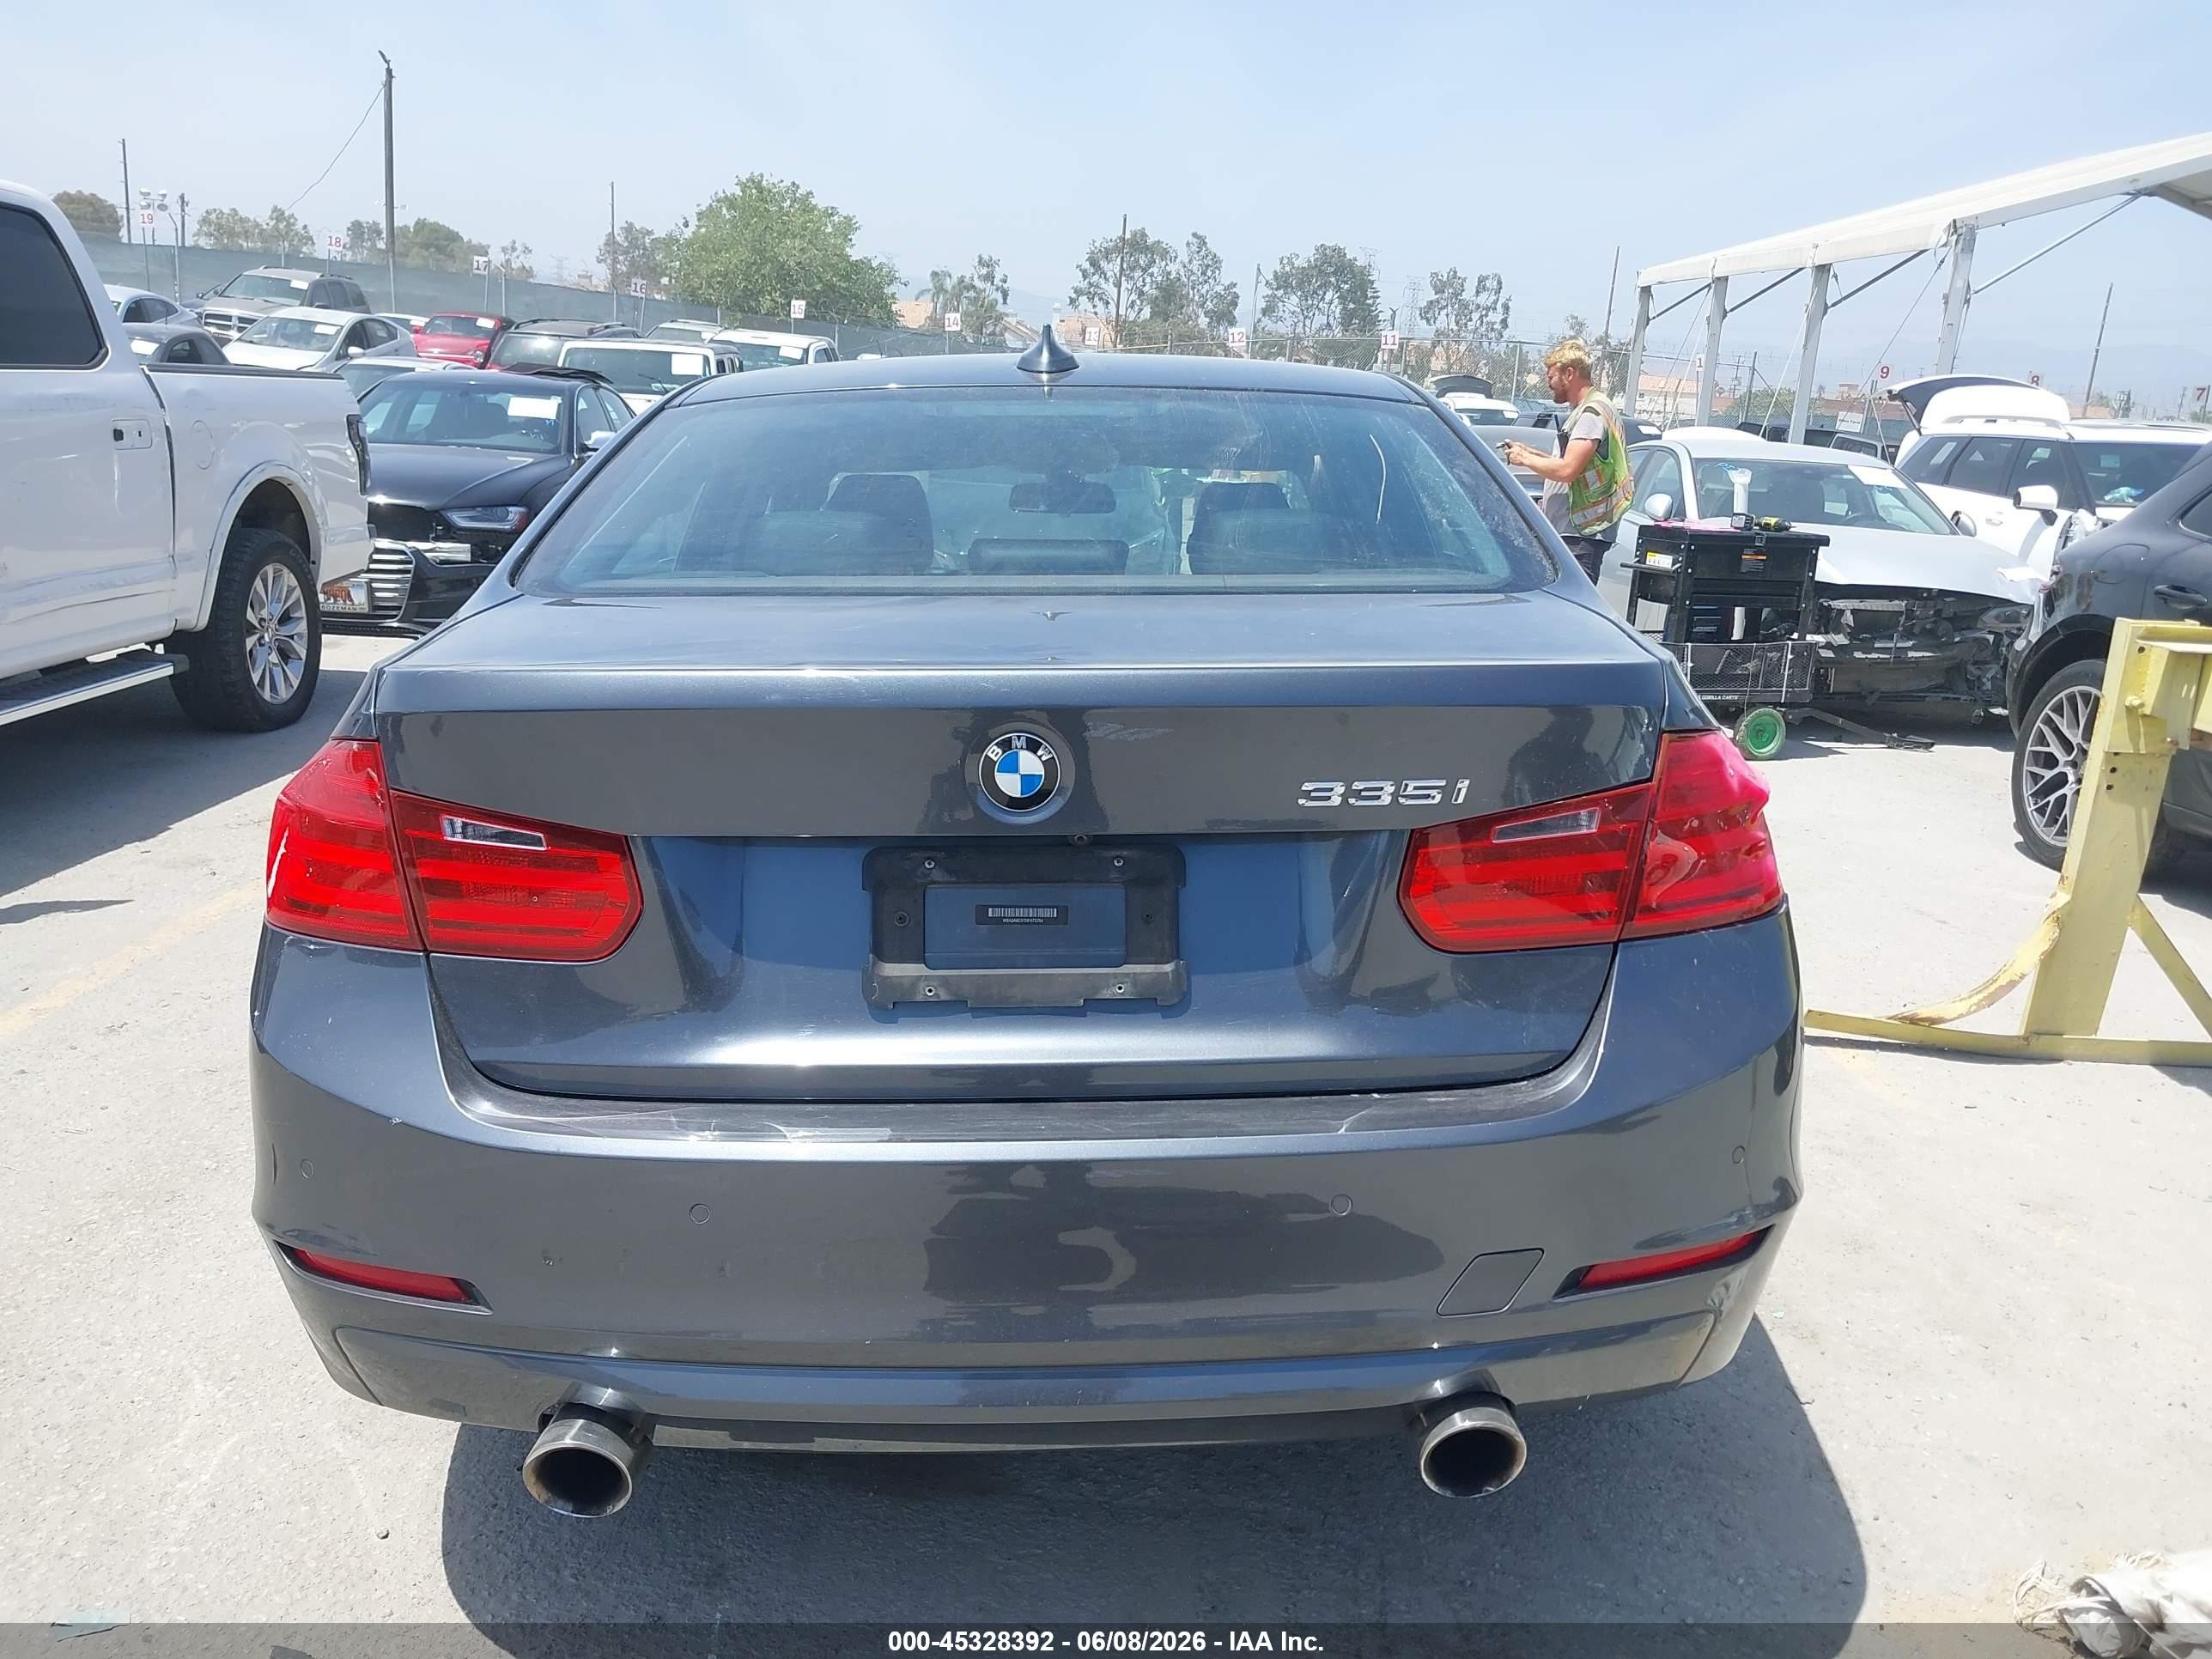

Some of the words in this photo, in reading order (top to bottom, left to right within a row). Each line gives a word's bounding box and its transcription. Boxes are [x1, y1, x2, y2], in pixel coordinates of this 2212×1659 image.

[140, 213, 153, 224] 19
[327, 235, 342, 247] 18
[474, 260, 488, 271] 17
[632, 283, 646, 294] 16
[792, 304, 804, 315] 15
[945, 316, 959, 328] 14
[1230, 331, 1245, 343] 12
[1382, 334, 1398, 345] 11
[1880, 366, 1890, 379] 9
[2030, 375, 2039, 386] 8
[2197, 387, 2206, 401] 7
[987, 736, 1054, 762] BMW
[1297, 779, 1470, 807] 335i
